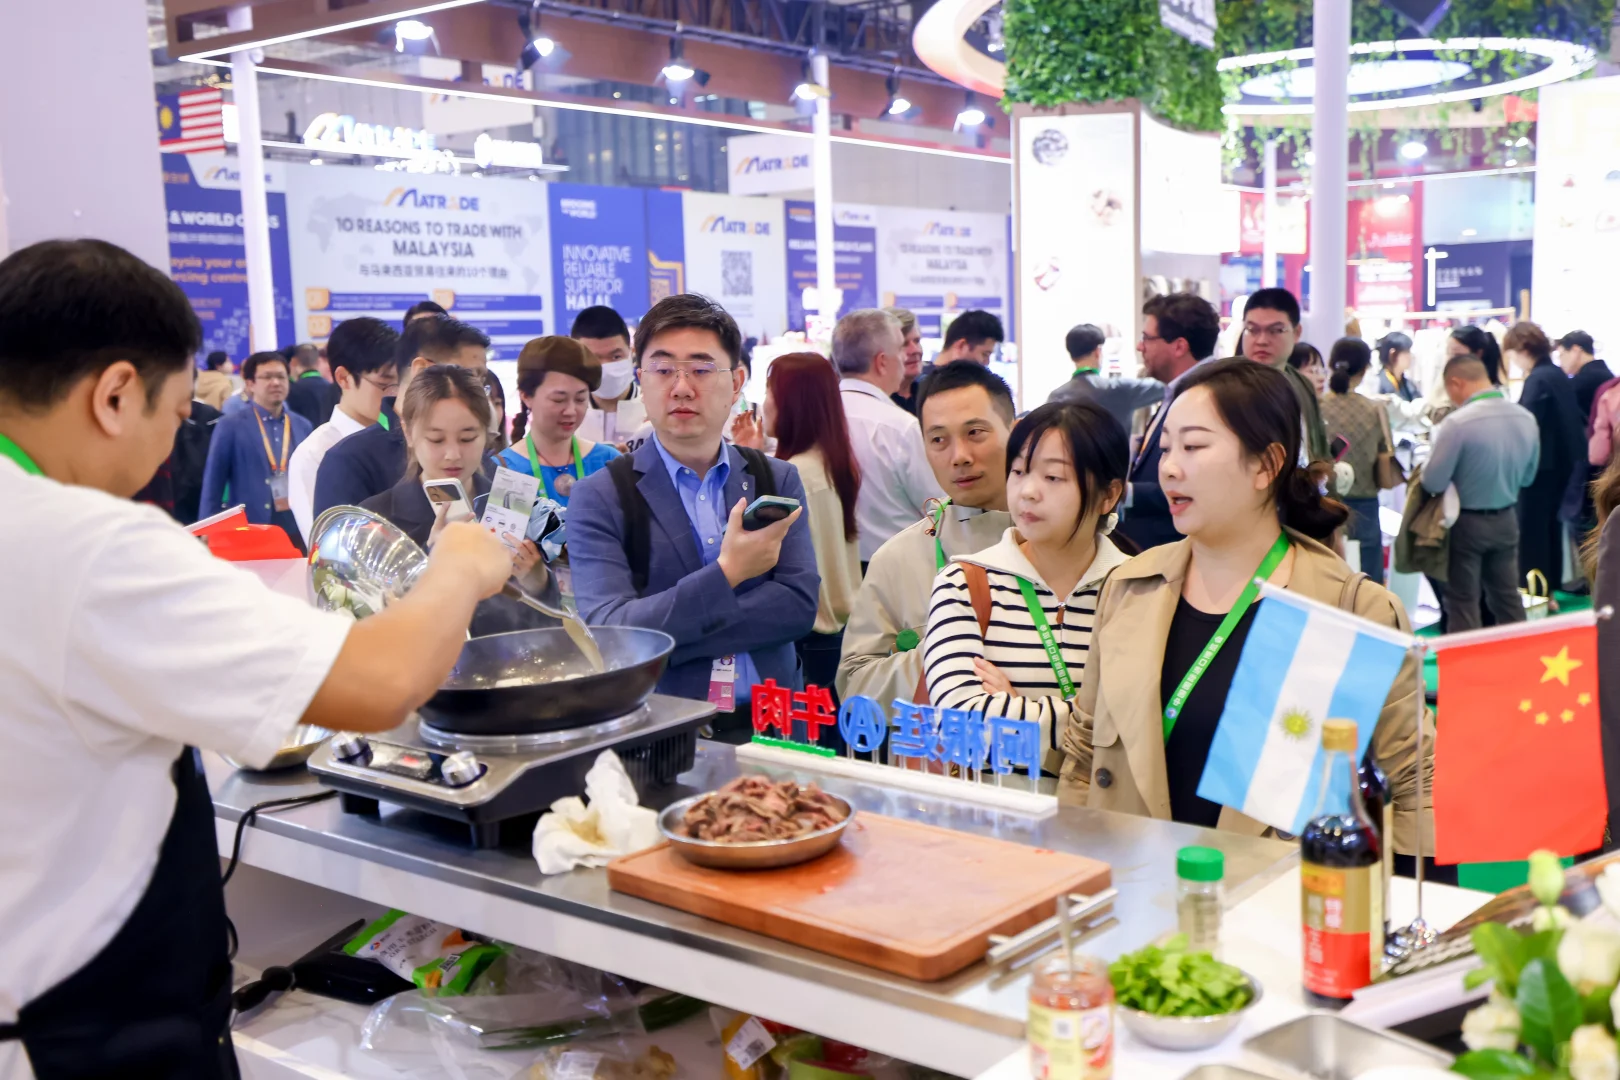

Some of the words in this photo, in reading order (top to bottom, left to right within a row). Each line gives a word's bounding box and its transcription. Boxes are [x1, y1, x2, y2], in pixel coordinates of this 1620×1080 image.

[735, 155, 809, 175] MATRADE
[382, 186, 480, 211] MATRADE
[181, 211, 235, 227] WORLD
[335, 216, 353, 232] 10
[357, 218, 421, 235] REASONS
[425, 222, 443, 236] TO
[447, 222, 487, 238] TRADE
[490, 225, 522, 239] WITH
[700, 214, 771, 235] MATRADE
[393, 240, 475, 258] MALAYSIA
[562, 244, 632, 263] INNOVATIVE
[563, 261, 616, 278] RELIABLE
[564, 278, 623, 294] SUPERIOR
